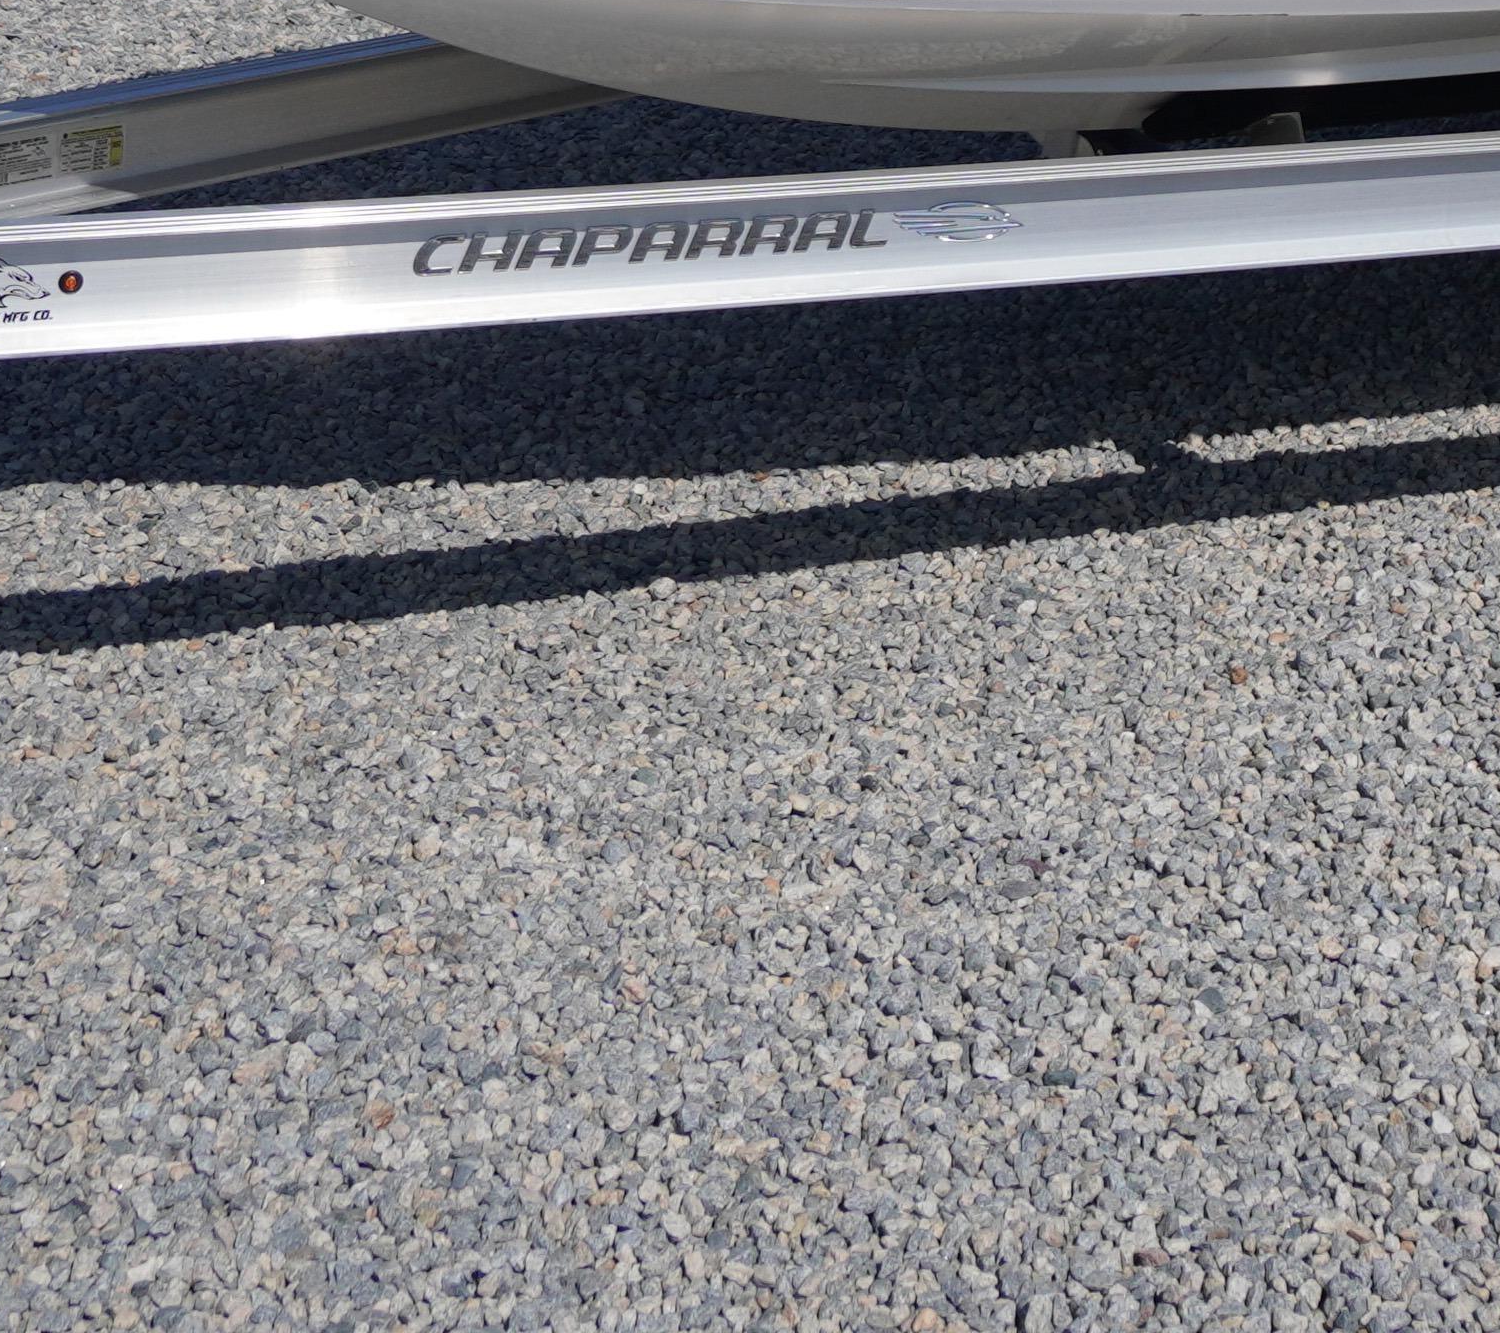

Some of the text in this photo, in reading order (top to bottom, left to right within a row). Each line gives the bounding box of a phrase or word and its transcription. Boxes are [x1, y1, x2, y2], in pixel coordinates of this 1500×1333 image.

[412, 207, 889, 278] CHAPARRAL
[2, 310, 31, 324] MFG
[33, 309, 54, 322] CO.
